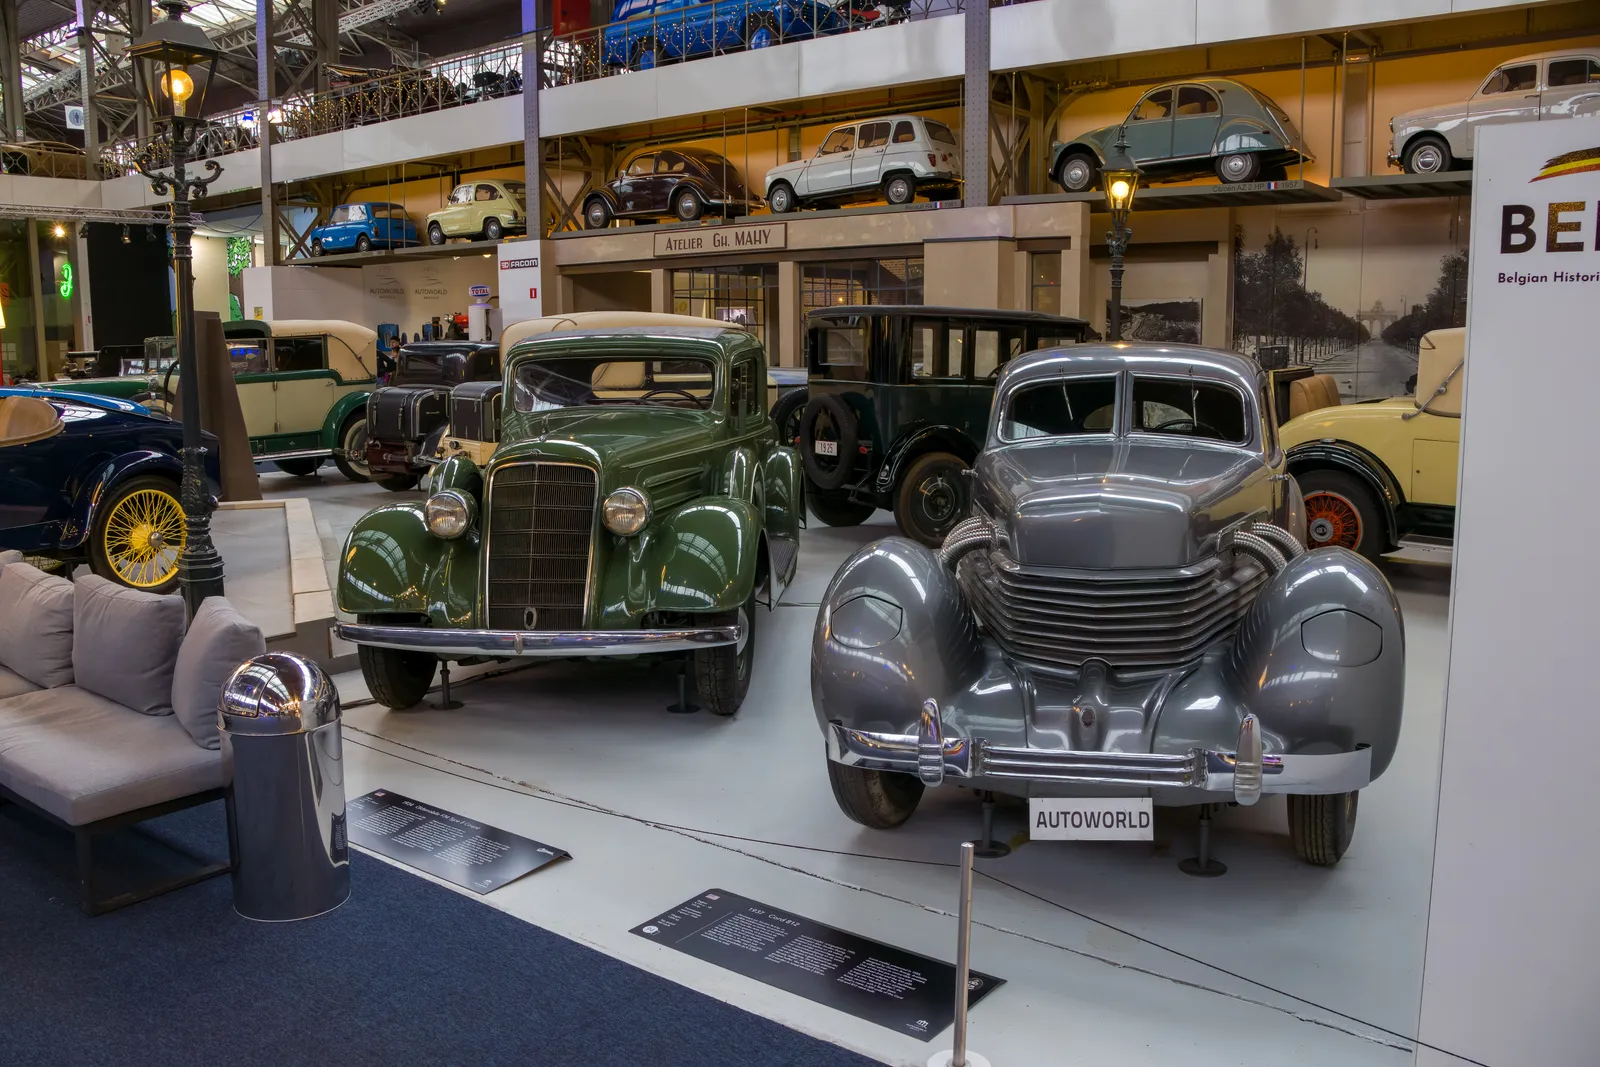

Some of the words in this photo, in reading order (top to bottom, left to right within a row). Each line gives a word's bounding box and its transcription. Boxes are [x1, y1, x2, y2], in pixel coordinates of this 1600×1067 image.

[1500, 200, 1600, 254] BE
[735, 229, 771, 246] MAHY
[510, 259, 538, 269] FACOM
[1498, 272, 1548, 286] Belgian
[1036, 811, 1150, 829] AUTOWORLD
